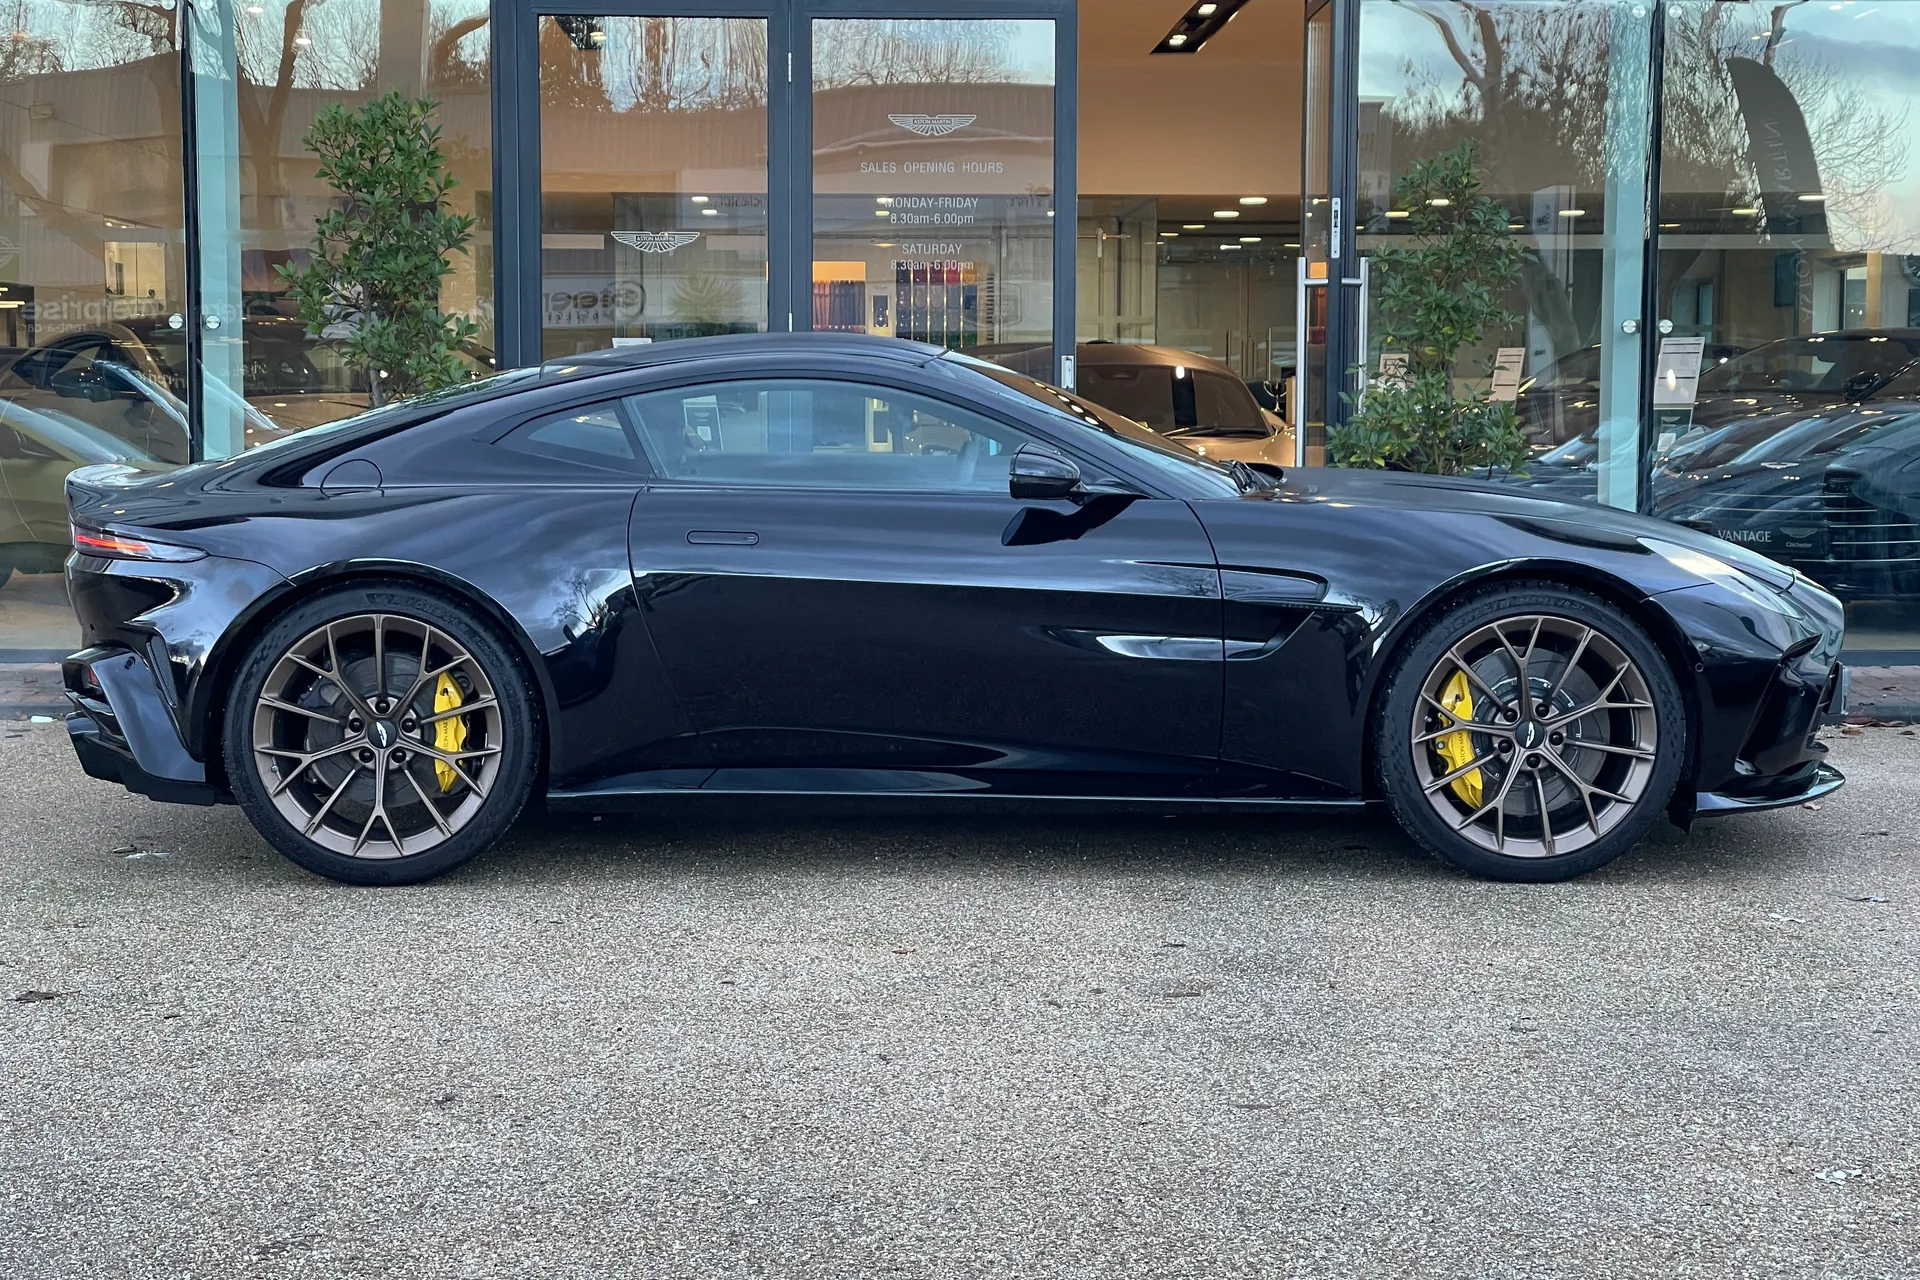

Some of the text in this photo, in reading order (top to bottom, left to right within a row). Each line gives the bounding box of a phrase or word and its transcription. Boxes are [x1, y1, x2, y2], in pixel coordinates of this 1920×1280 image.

[860, 162, 1004, 174] SALES OPENING HOURS
[884, 197, 979, 209] MONDAY-FRIDAY
[890, 213, 975, 226] 8.30am-6.00pm
[902, 243, 963, 255] SATURDAY
[890, 260, 975, 272] 8.30am-6.00pm
[1717, 529, 1772, 543] VANTAGE
